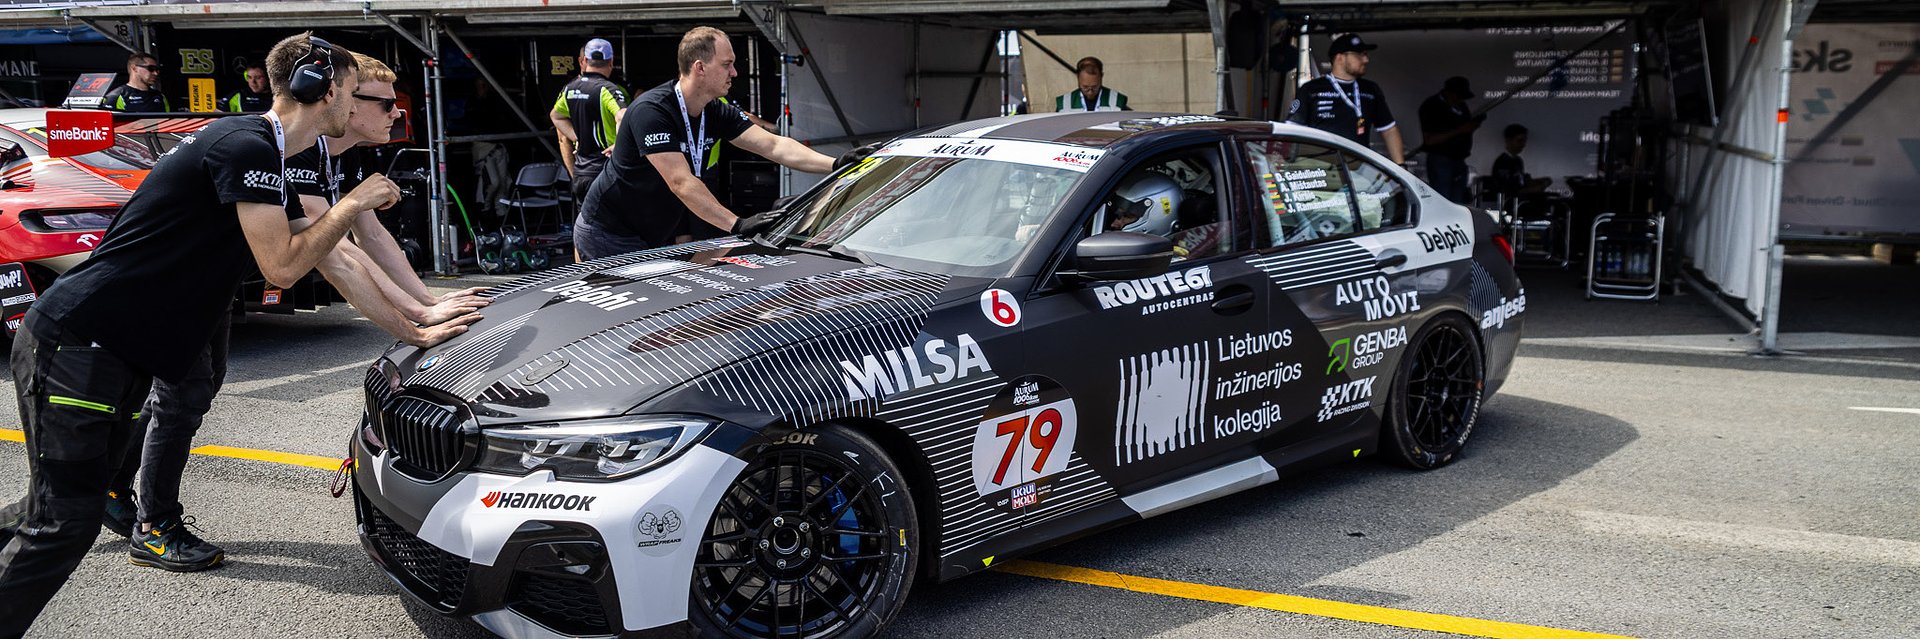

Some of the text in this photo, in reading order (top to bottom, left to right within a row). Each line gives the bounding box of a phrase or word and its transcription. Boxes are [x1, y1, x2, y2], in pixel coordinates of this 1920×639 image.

[114, 24, 128, 37] 18
[179, 48, 215, 74] ES
[550, 56, 575, 75] ES
[50, 127, 102, 140] smeBank
[652, 133, 671, 141] KTK
[928, 144, 995, 156] AURUM
[296, 169, 319, 181] KTK
[1416, 223, 1471, 254] Delphi
[542, 279, 649, 312] Delphi
[1336, 275, 1390, 306] AUTO
[991, 290, 1017, 325] 6
[1142, 292, 1215, 316] AUTOCENTRAS
[1364, 290, 1421, 322] MOVI
[1218, 328, 1293, 362] Lietuvos
[1354, 326, 1408, 356] GENBA
[840, 333, 993, 402] MILSA
[1352, 352, 1384, 369] GROUP
[1014, 382, 1040, 397] AURUM
[1216, 361, 1302, 400] inžinerijos
[1338, 375, 1377, 406] KTK
[1214, 400, 1282, 439] kolegija
[1333, 405, 1350, 416] RACING
[991, 408, 1063, 487] 79
[1013, 484, 1035, 499] LIQUI
[1013, 493, 1036, 508] MOLY
